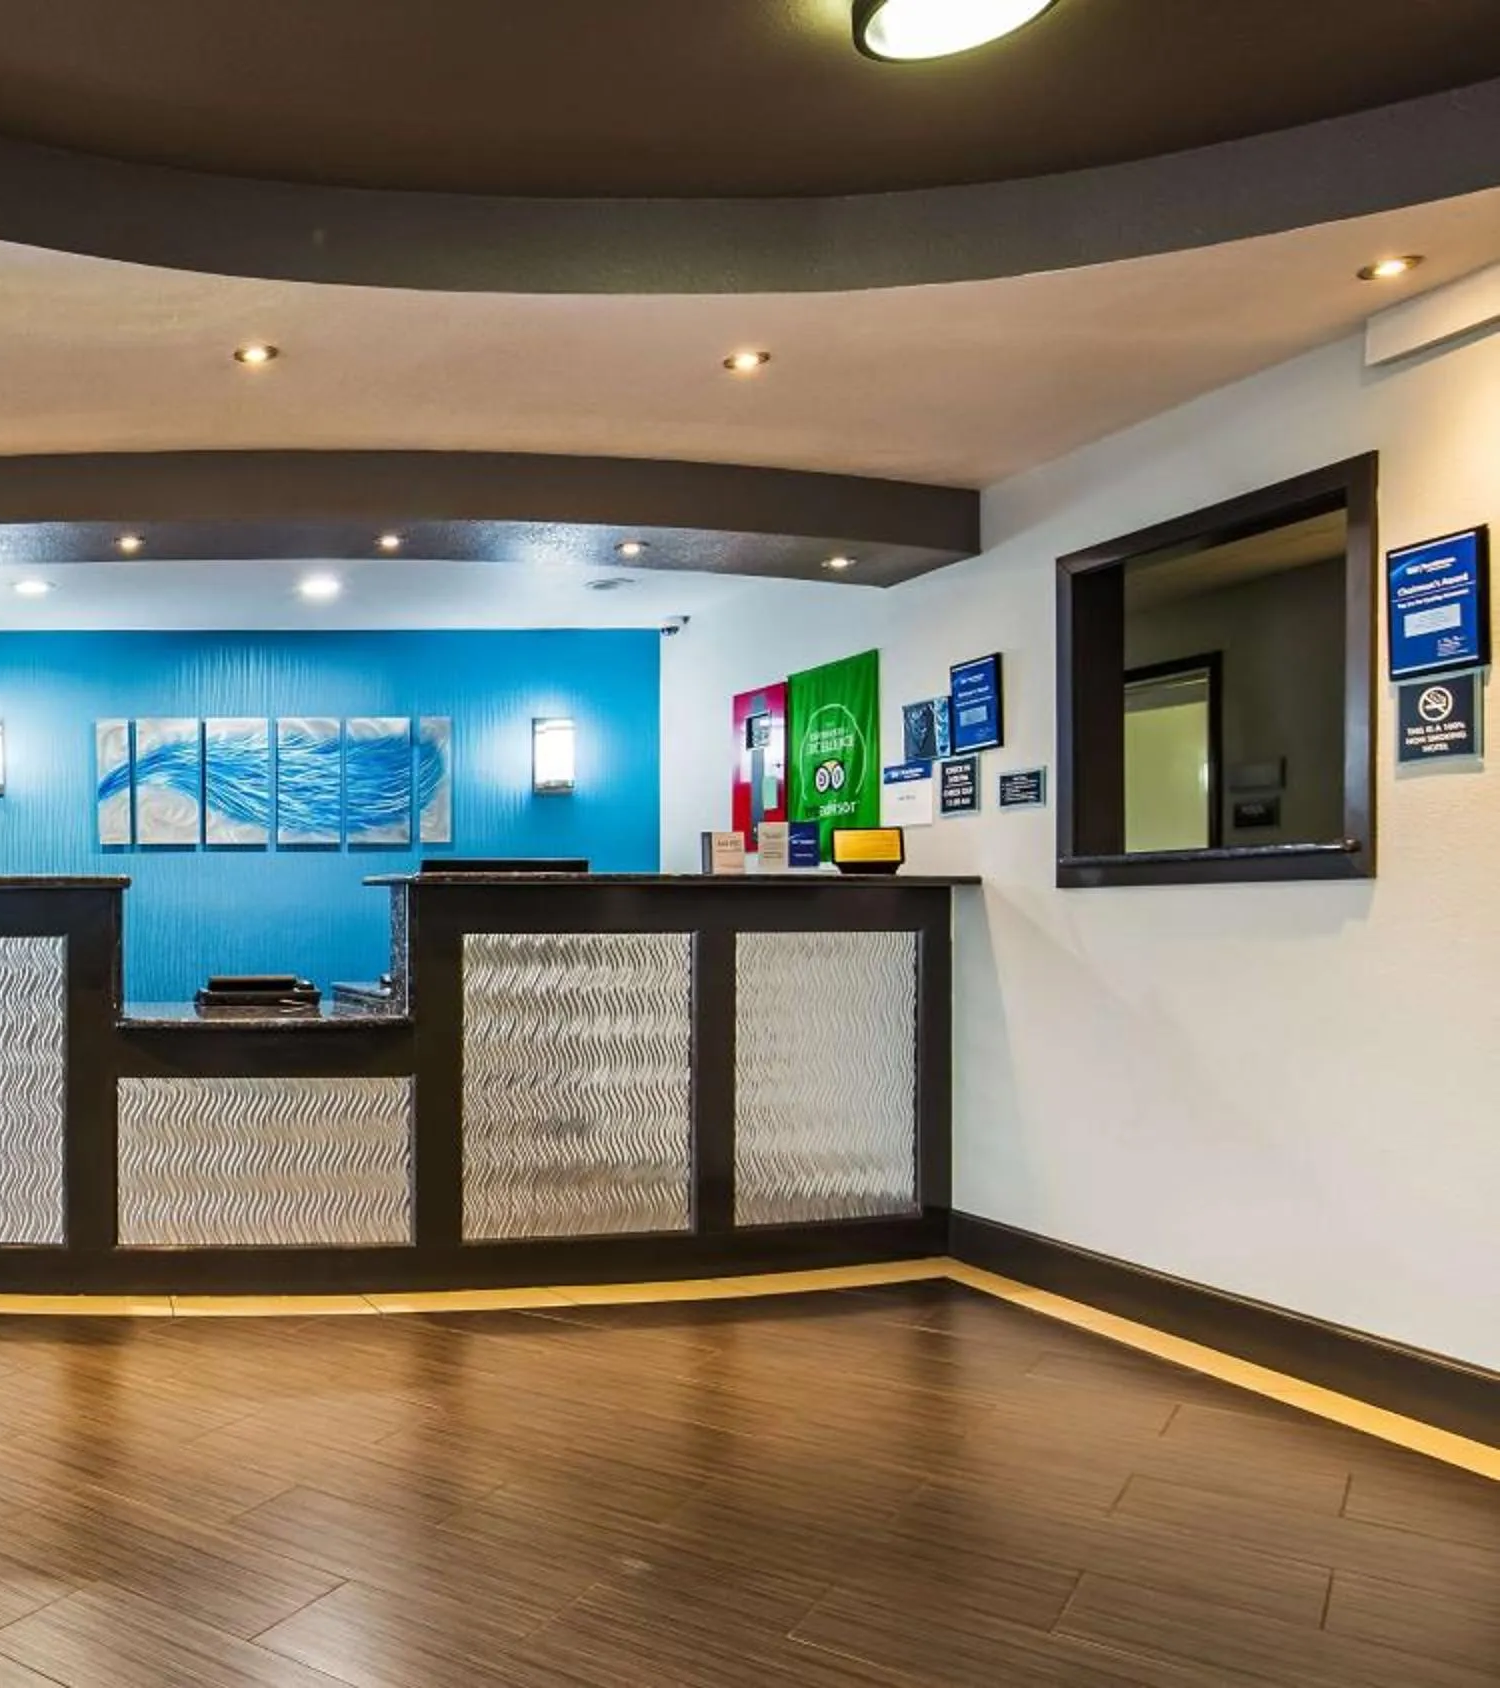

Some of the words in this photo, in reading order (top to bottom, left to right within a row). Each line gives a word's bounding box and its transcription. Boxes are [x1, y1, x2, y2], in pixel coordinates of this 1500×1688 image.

[1427, 730, 1467, 743] SMOKING
[945, 766, 963, 775] CHECK
[943, 788, 961, 797] CHECK
